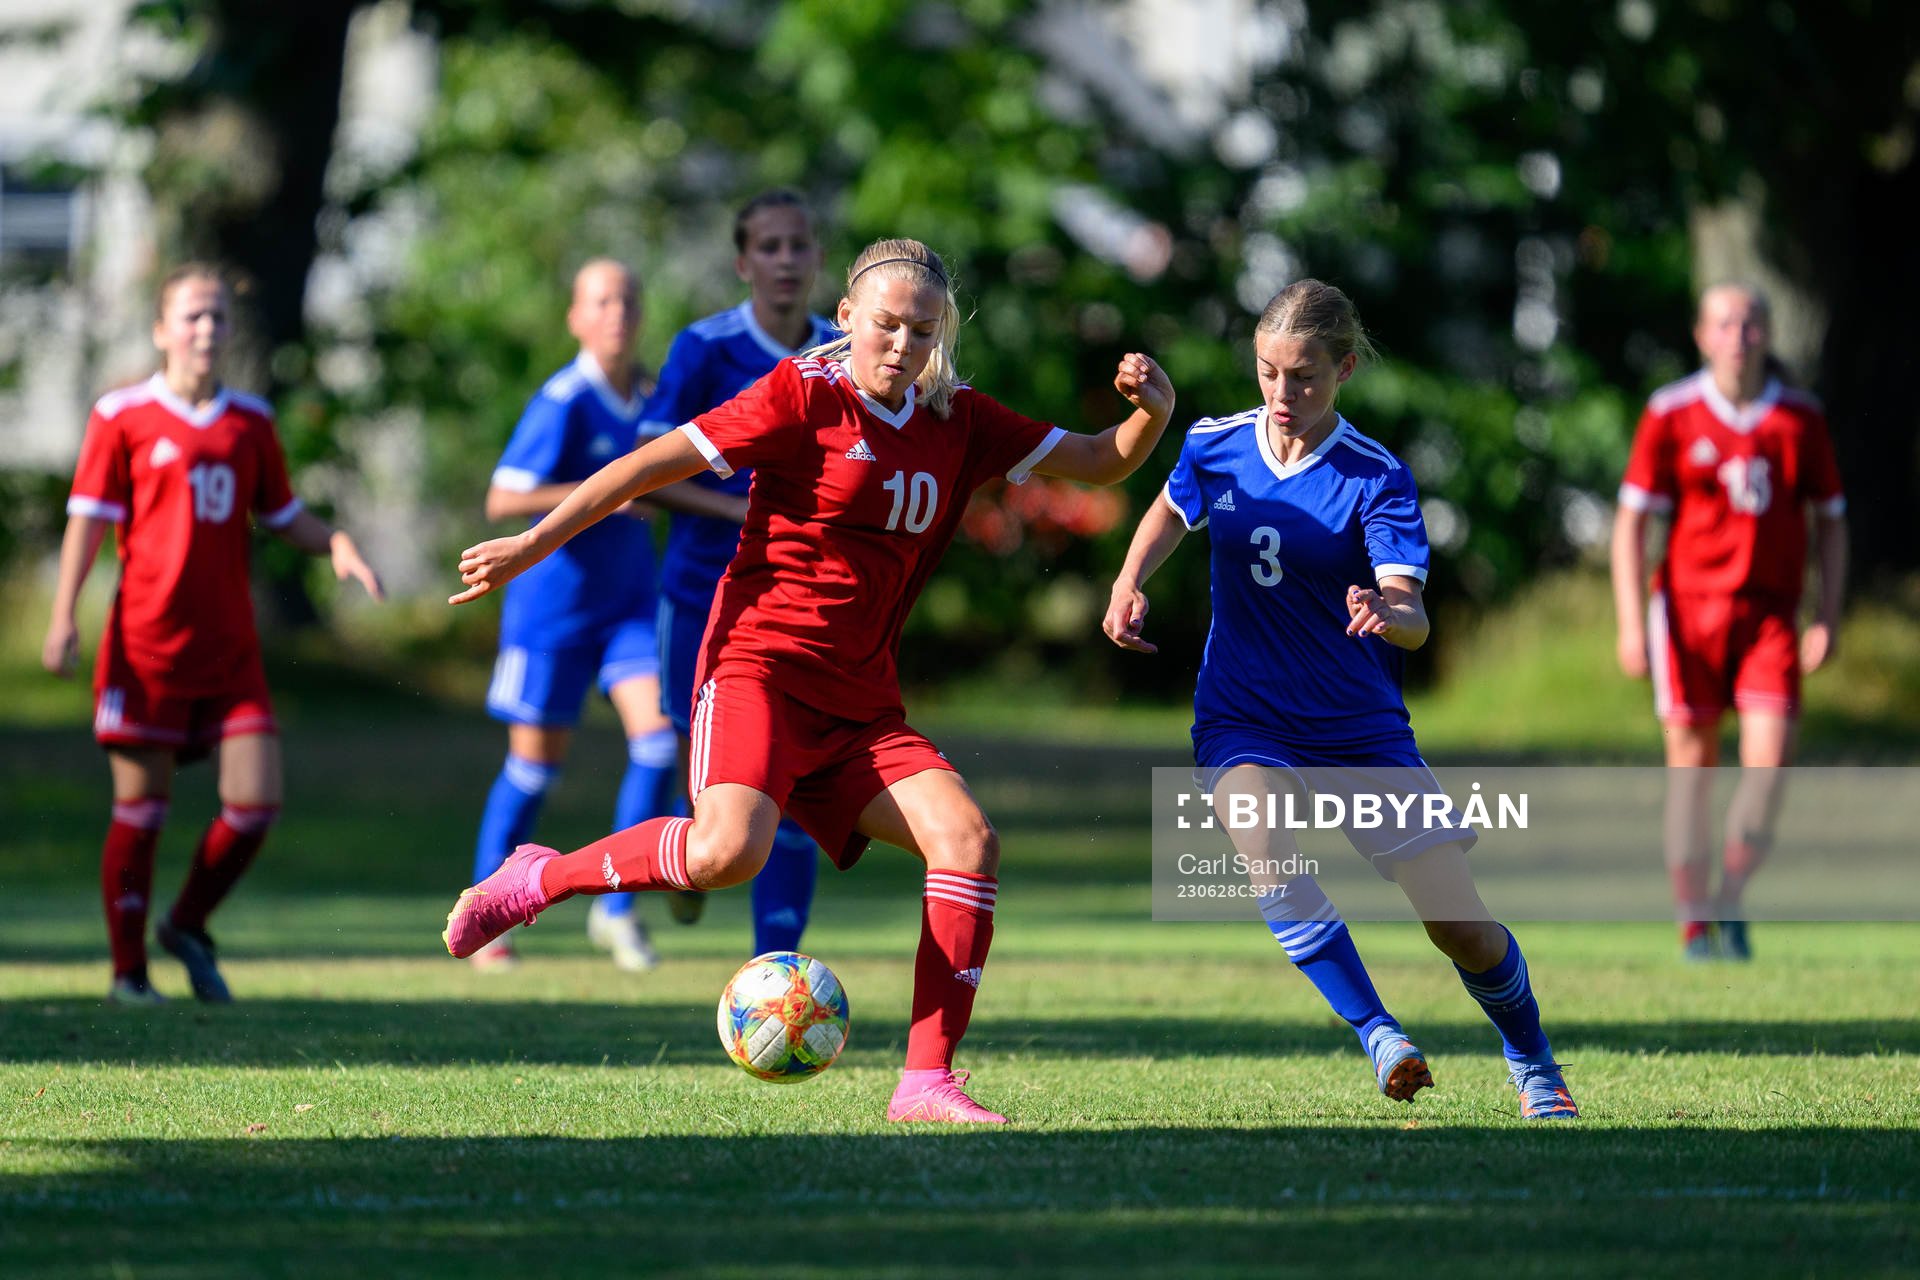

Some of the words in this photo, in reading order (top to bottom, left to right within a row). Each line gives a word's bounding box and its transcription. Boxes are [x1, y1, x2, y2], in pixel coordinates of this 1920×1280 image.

[186, 462, 236, 523] 19
[882, 470, 938, 533] 10
[1249, 526, 1283, 587] 3
